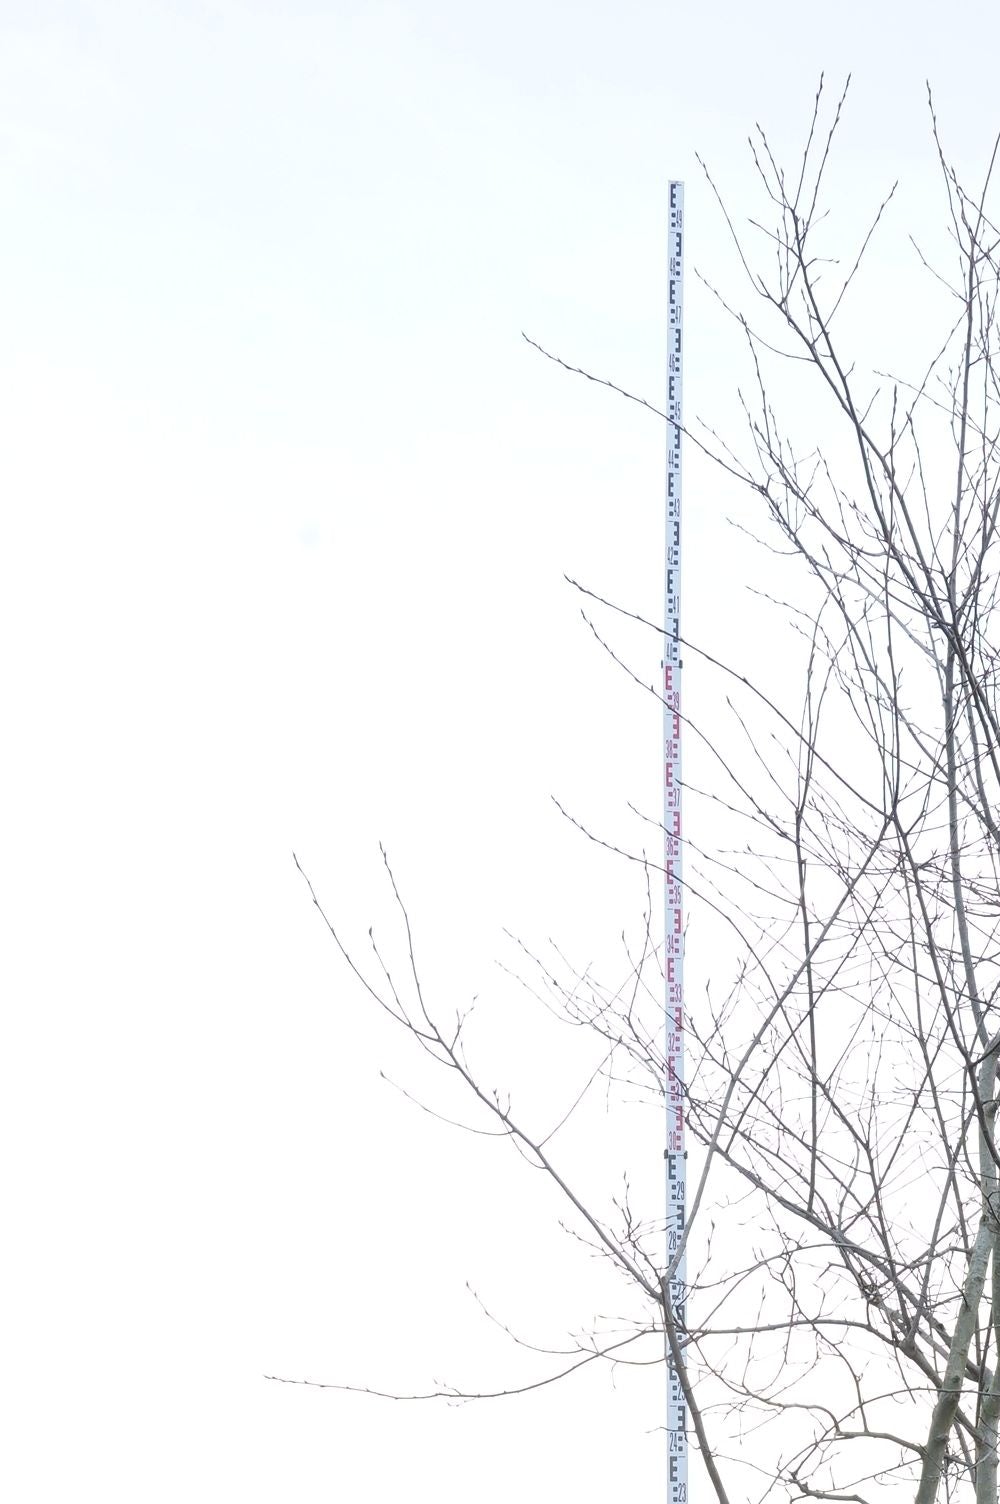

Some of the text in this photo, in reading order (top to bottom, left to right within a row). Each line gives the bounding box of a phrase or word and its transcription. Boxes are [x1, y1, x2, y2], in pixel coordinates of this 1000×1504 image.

[677, 1181, 684, 1200] 29
[669, 1231, 676, 1250] 28
[678, 1483, 686, 1502] 23
